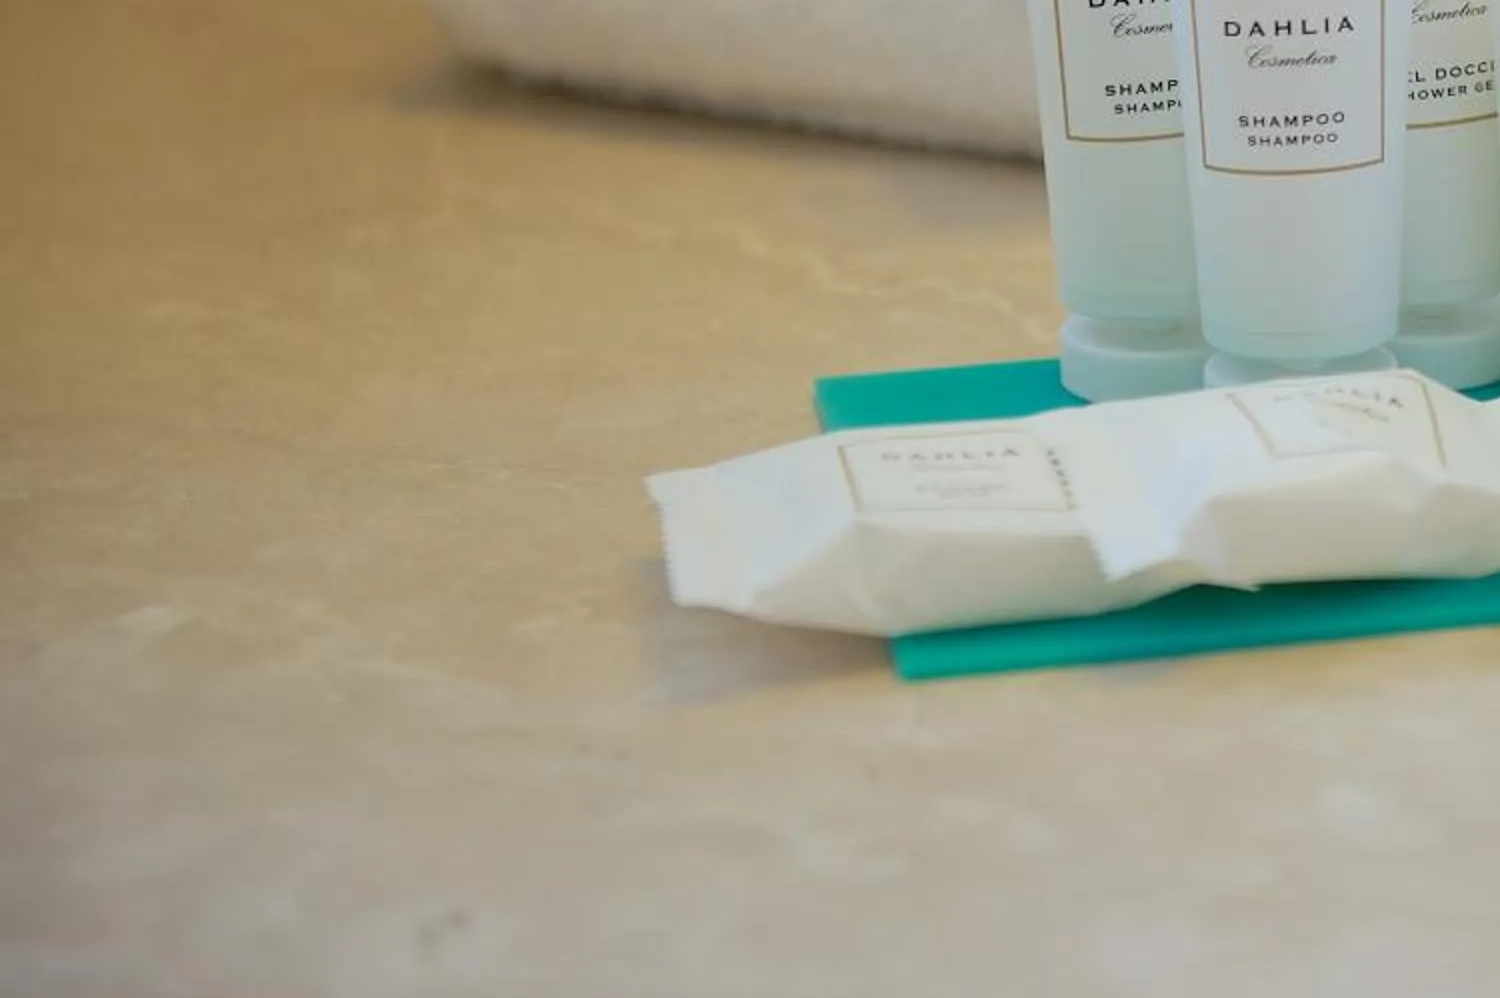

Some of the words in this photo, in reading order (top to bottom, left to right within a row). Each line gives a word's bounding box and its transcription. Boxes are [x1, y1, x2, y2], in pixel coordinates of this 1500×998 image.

[1224, 15, 1354, 37] DAHLIA
[1434, 59, 1496, 81] DOCCI
[1104, 78, 1179, 98] SHAMP
[1407, 84, 1468, 102] HOWER
[1473, 79, 1495, 94] GE
[1113, 98, 1182, 116] SHAMP
[1237, 110, 1346, 129] SHAMPOO
[1246, 132, 1340, 149] SHAMPOO
